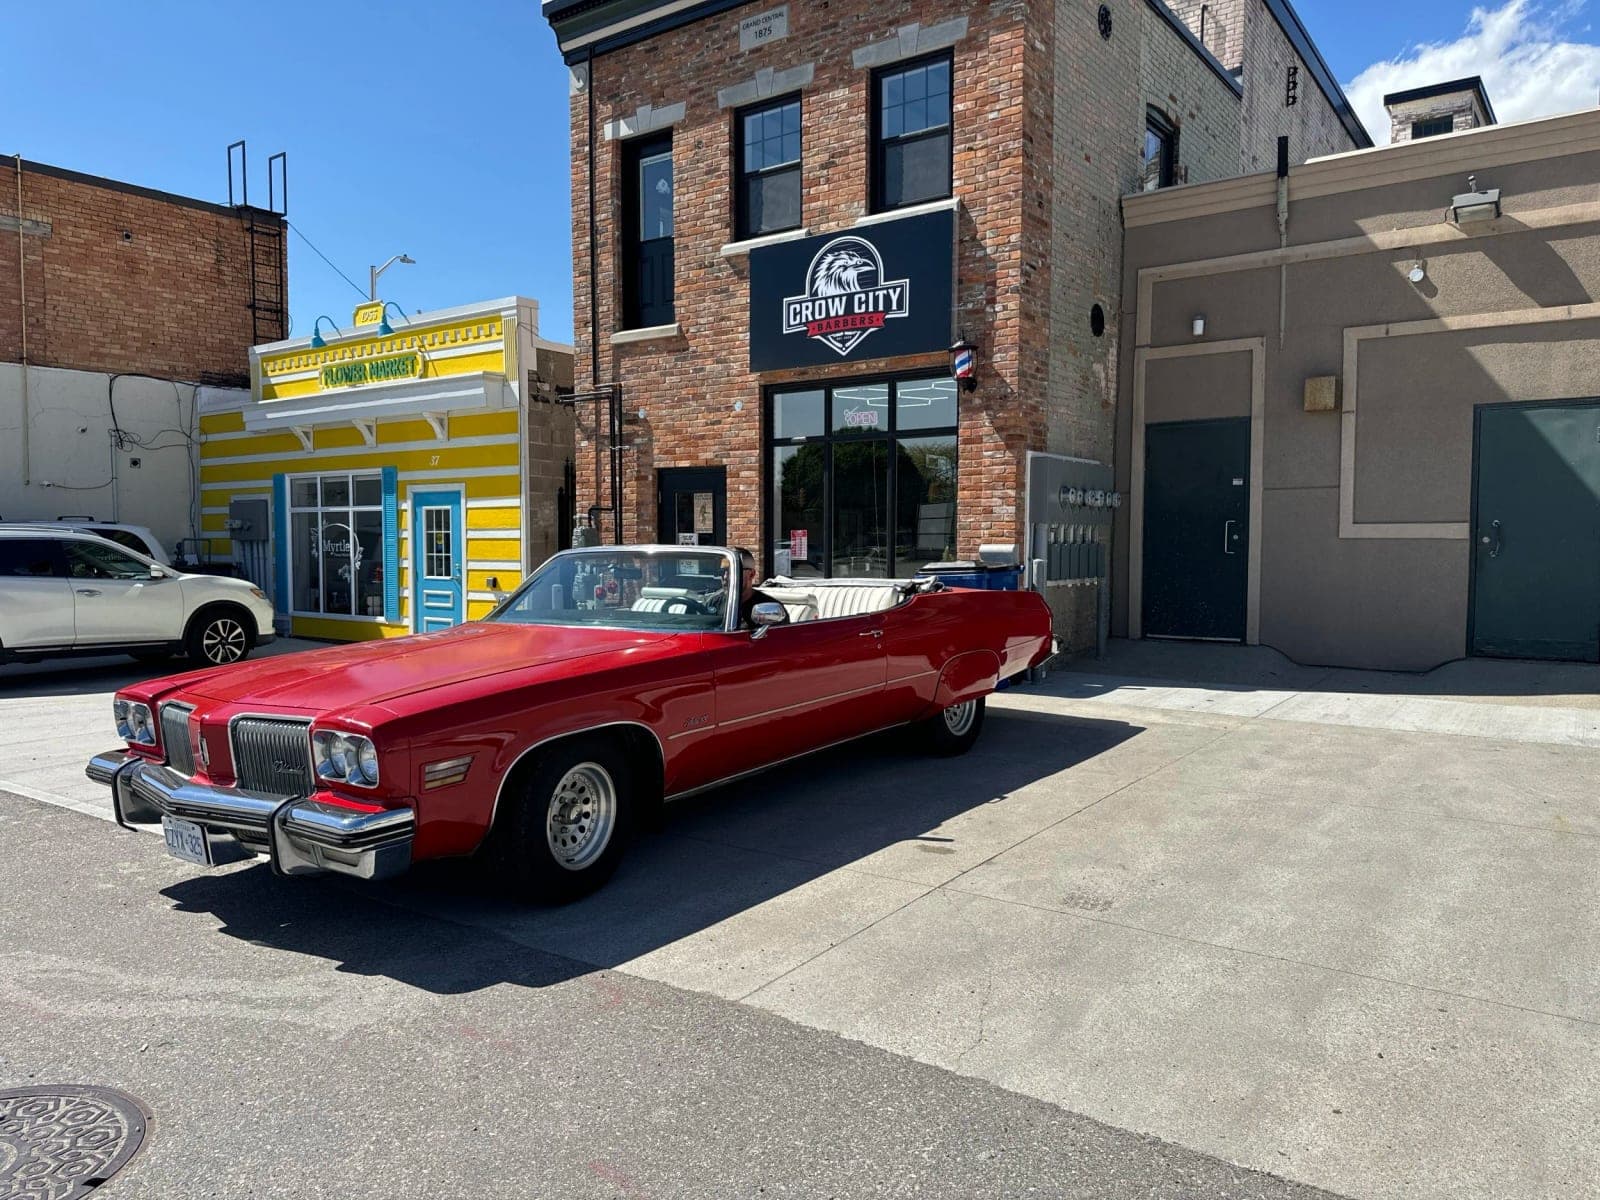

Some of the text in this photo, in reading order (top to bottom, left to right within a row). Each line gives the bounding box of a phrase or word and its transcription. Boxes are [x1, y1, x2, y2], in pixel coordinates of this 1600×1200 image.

[743, 12, 784, 30] GRAND CENTRAL
[754, 26, 772, 39] 1875
[789, 287, 902, 326] CROW CITY
[817, 316, 874, 332] BARBERS
[324, 356, 416, 386] FLOWER MARKET
[849, 413, 876, 425] OPEN
[429, 455, 441, 466] 37
